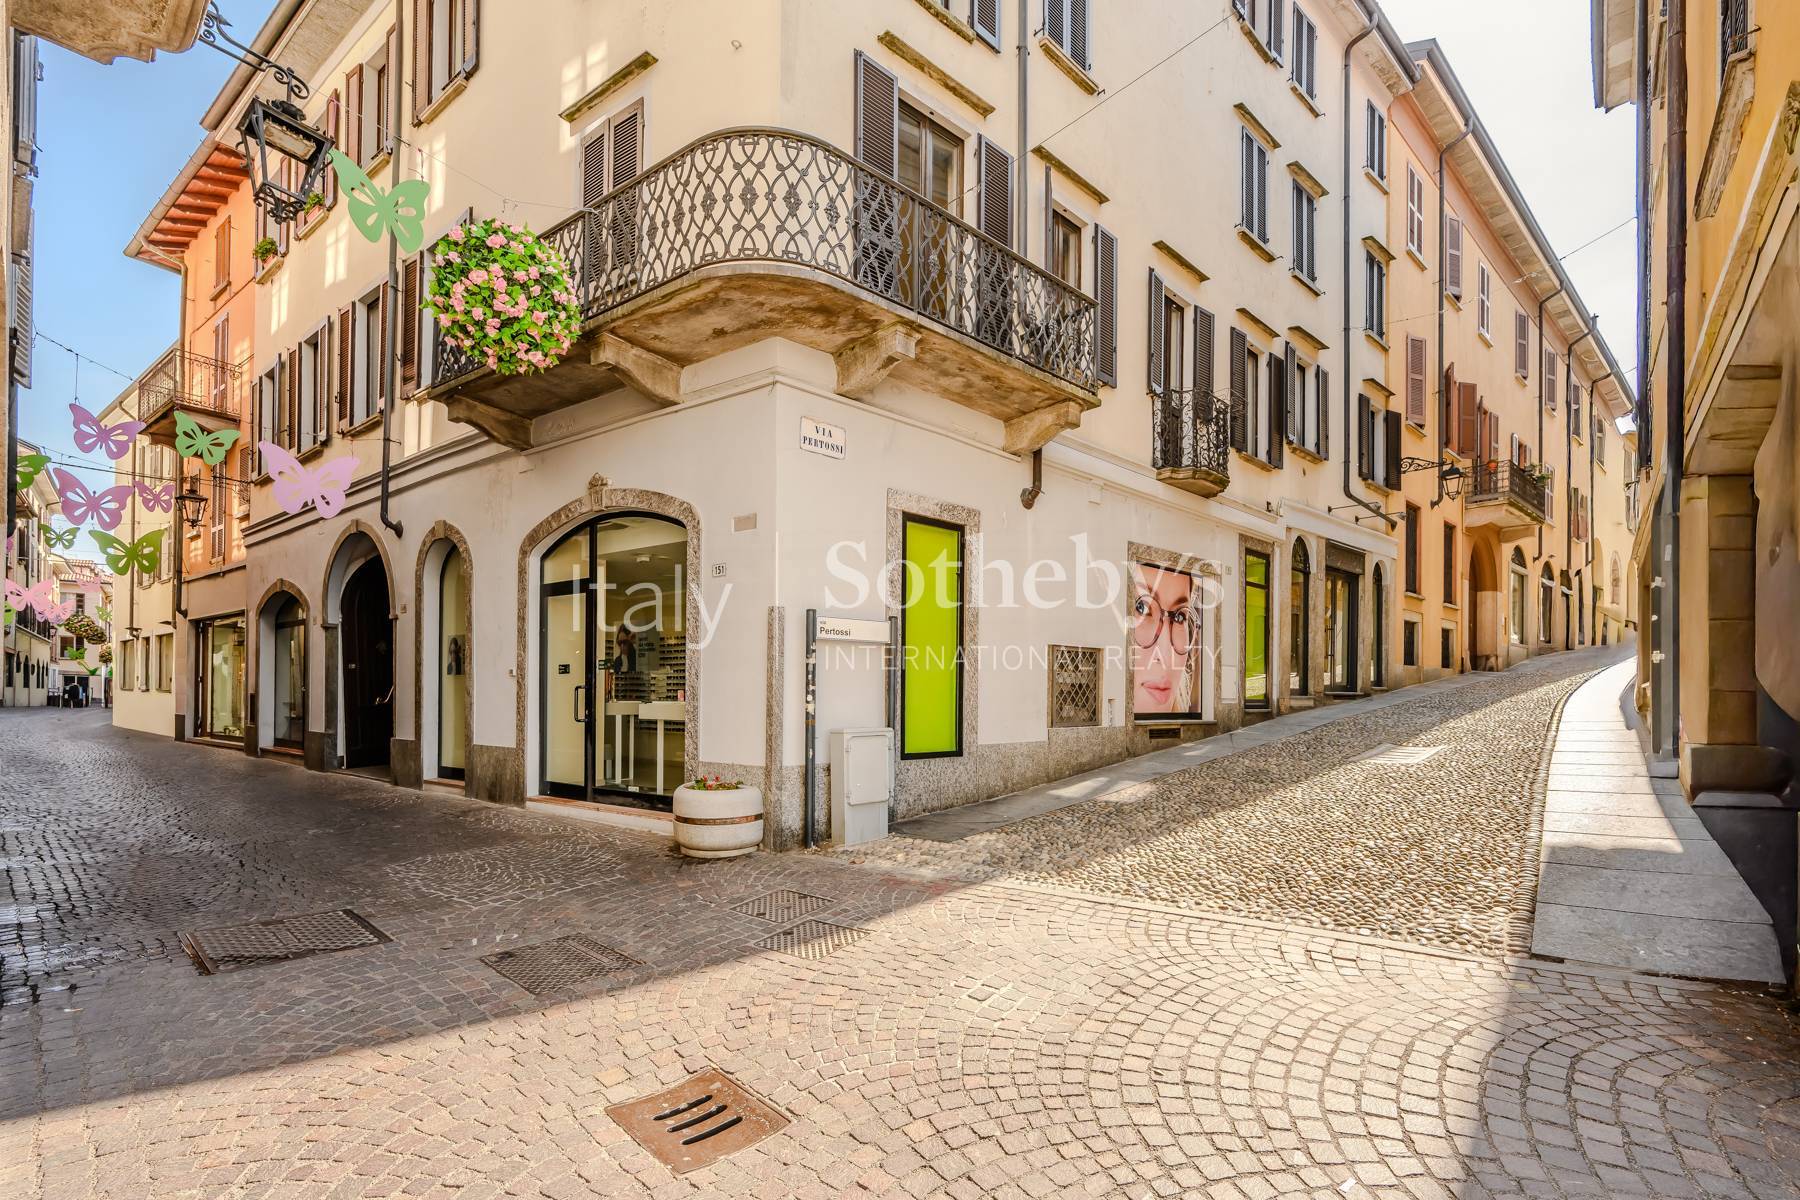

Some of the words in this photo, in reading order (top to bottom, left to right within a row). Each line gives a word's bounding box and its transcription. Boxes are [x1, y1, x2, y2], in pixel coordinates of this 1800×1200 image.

[815, 425, 833, 438] VIA
[803, 435, 843, 454] PERTOSSI
[714, 565, 725, 575] 151
[819, 626, 851, 637] Pertossi
